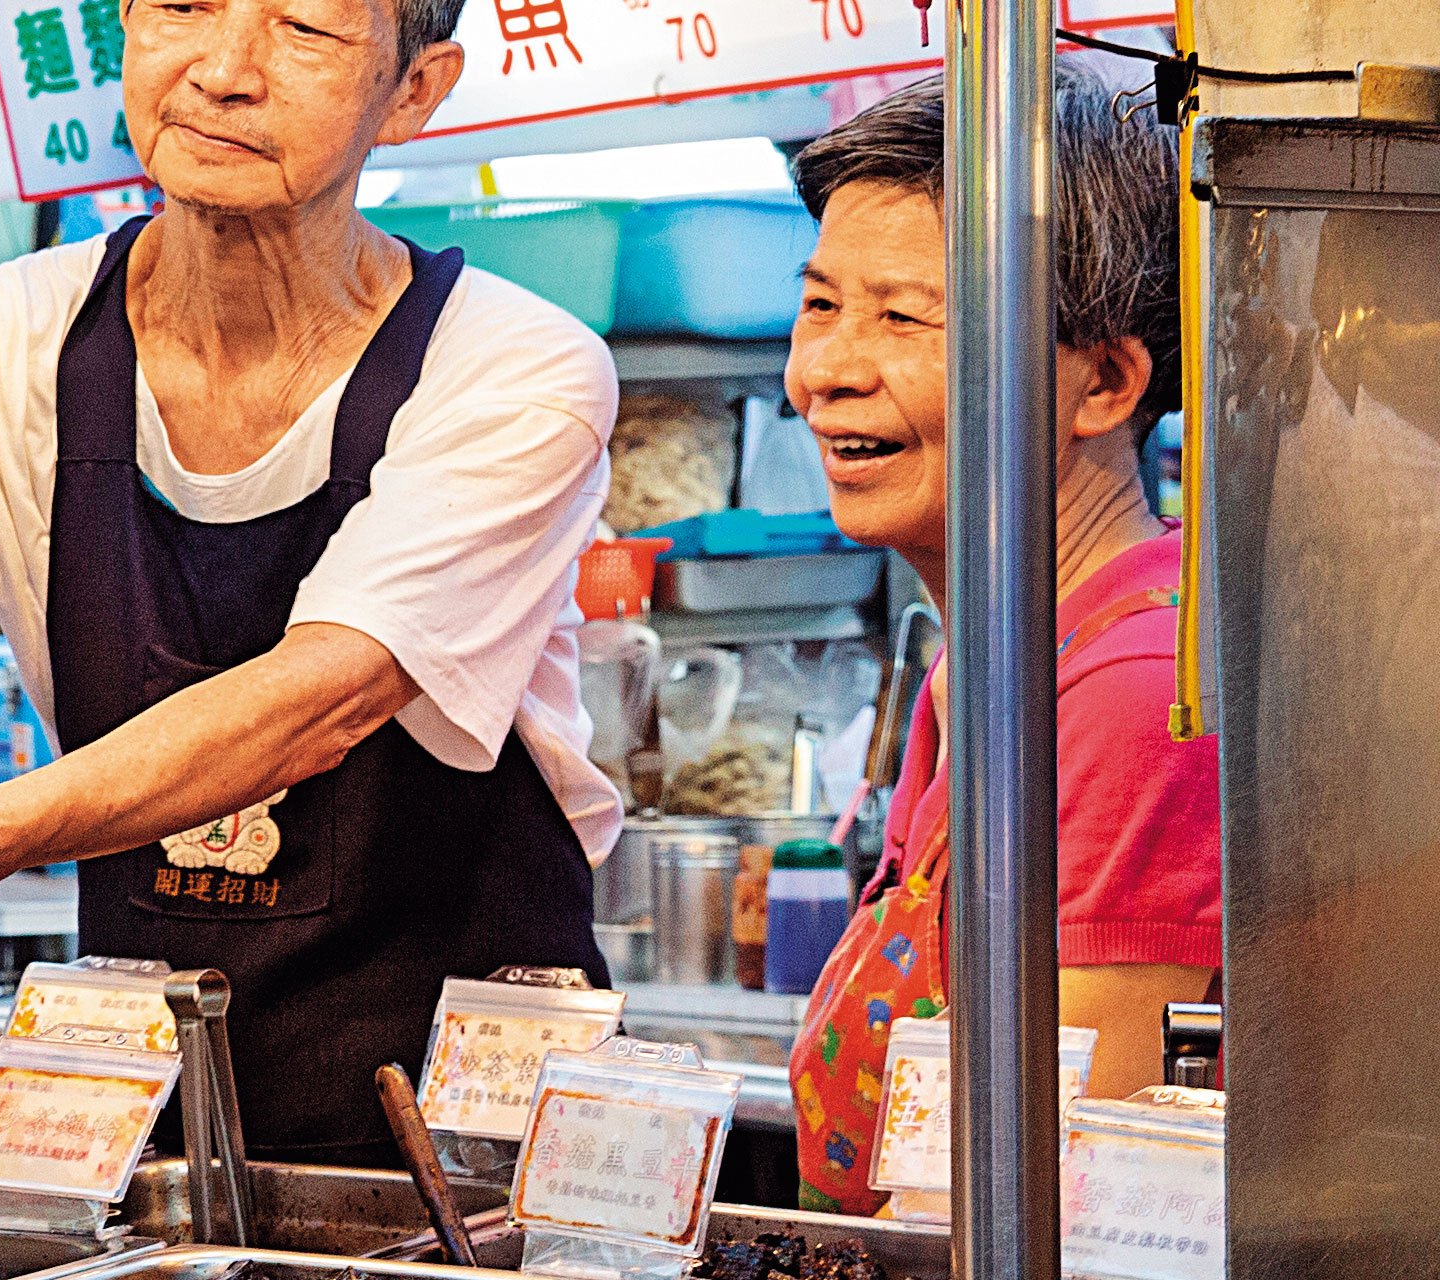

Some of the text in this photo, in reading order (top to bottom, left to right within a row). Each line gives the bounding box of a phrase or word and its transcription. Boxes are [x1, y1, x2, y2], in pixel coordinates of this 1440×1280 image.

[14, 7, 80, 99] 麵
[664, 13, 718, 61] 70
[44, 119, 90, 165] 40
[155, 867, 282, 908] 開運招財
